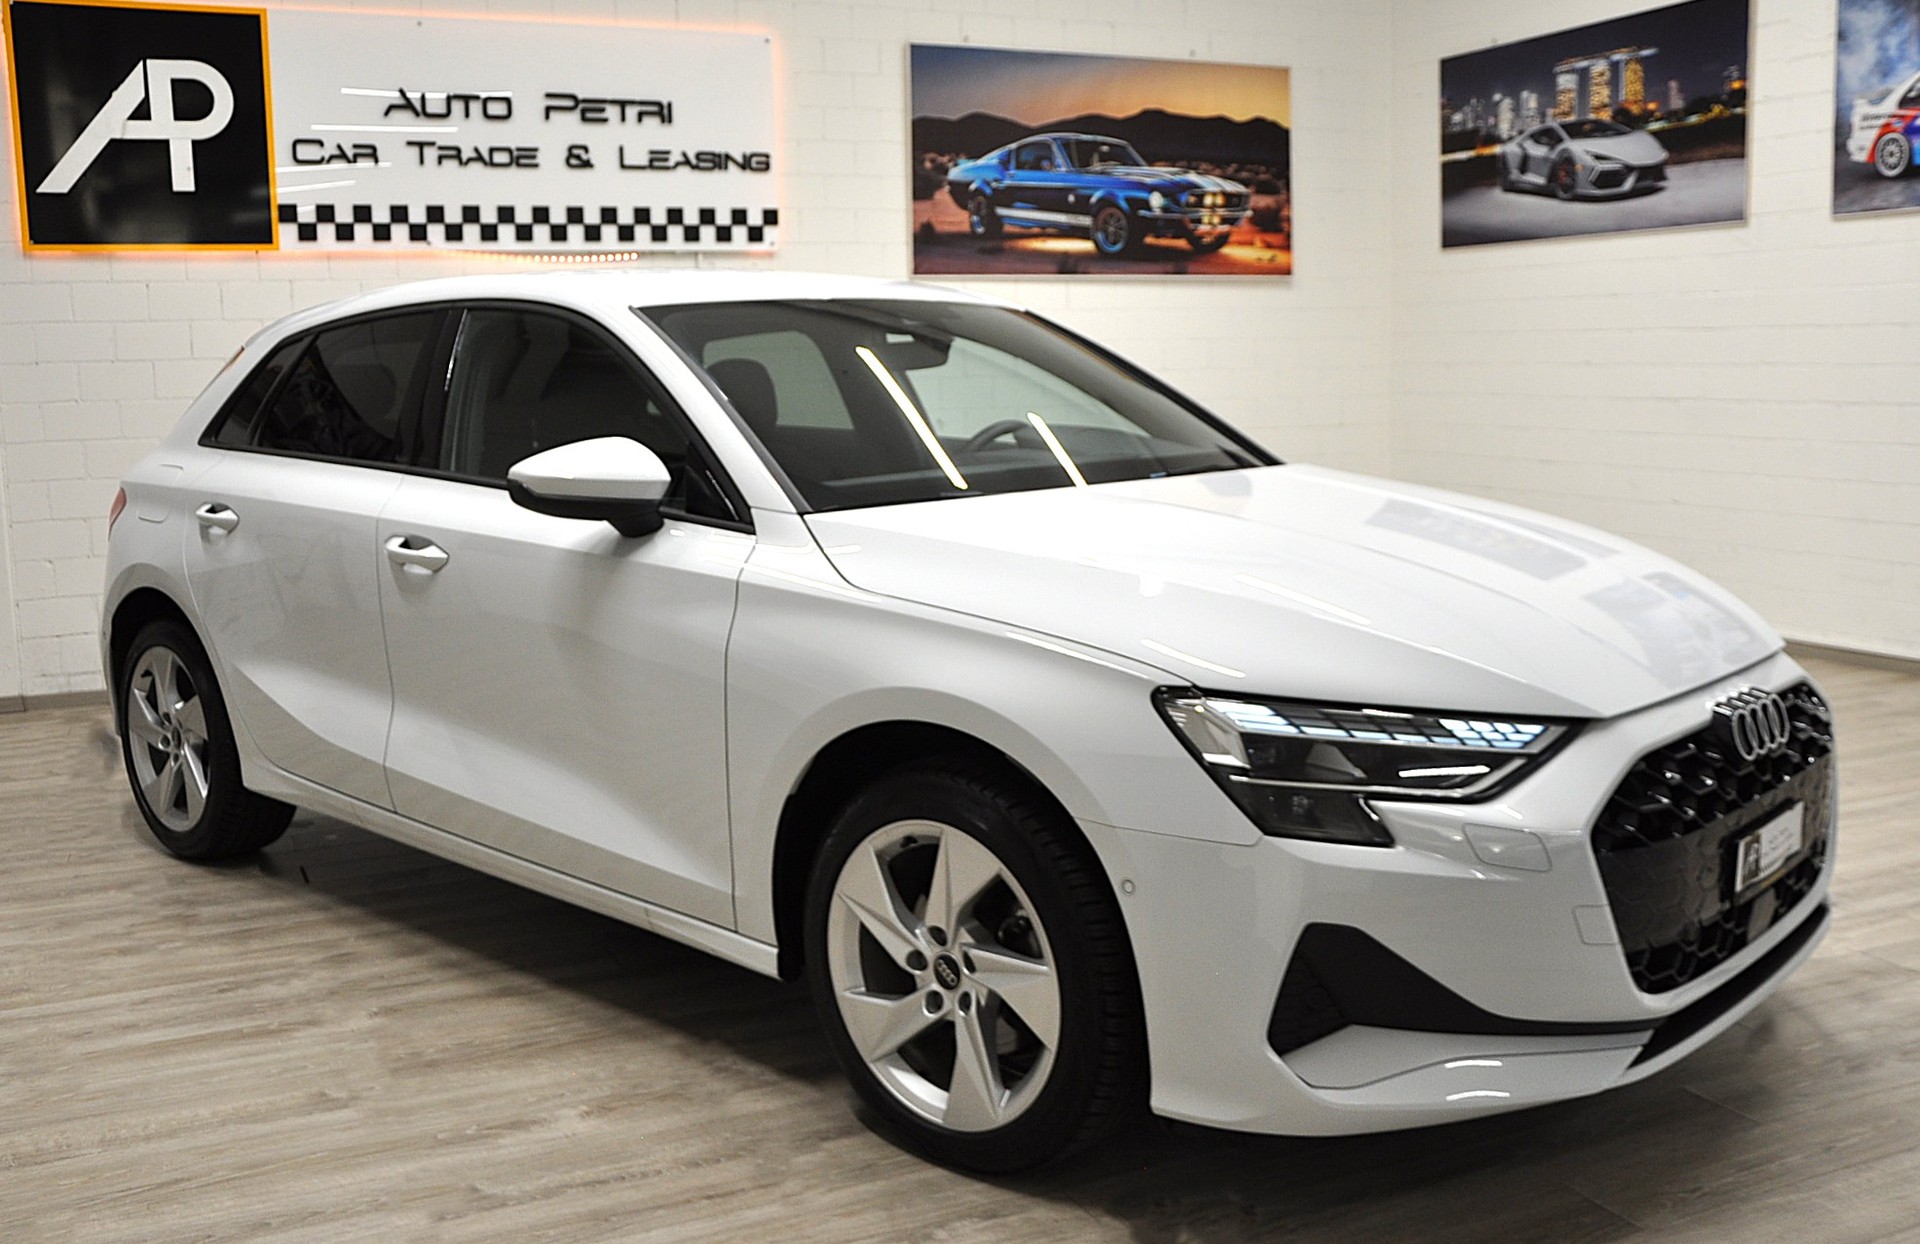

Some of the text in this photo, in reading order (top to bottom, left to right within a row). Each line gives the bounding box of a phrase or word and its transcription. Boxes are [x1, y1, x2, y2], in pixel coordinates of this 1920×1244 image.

[383, 87, 673, 124] AUTO PETRI
[35, 58, 235, 194] AP
[291, 138, 771, 172] CAR TRADE & LEASING
